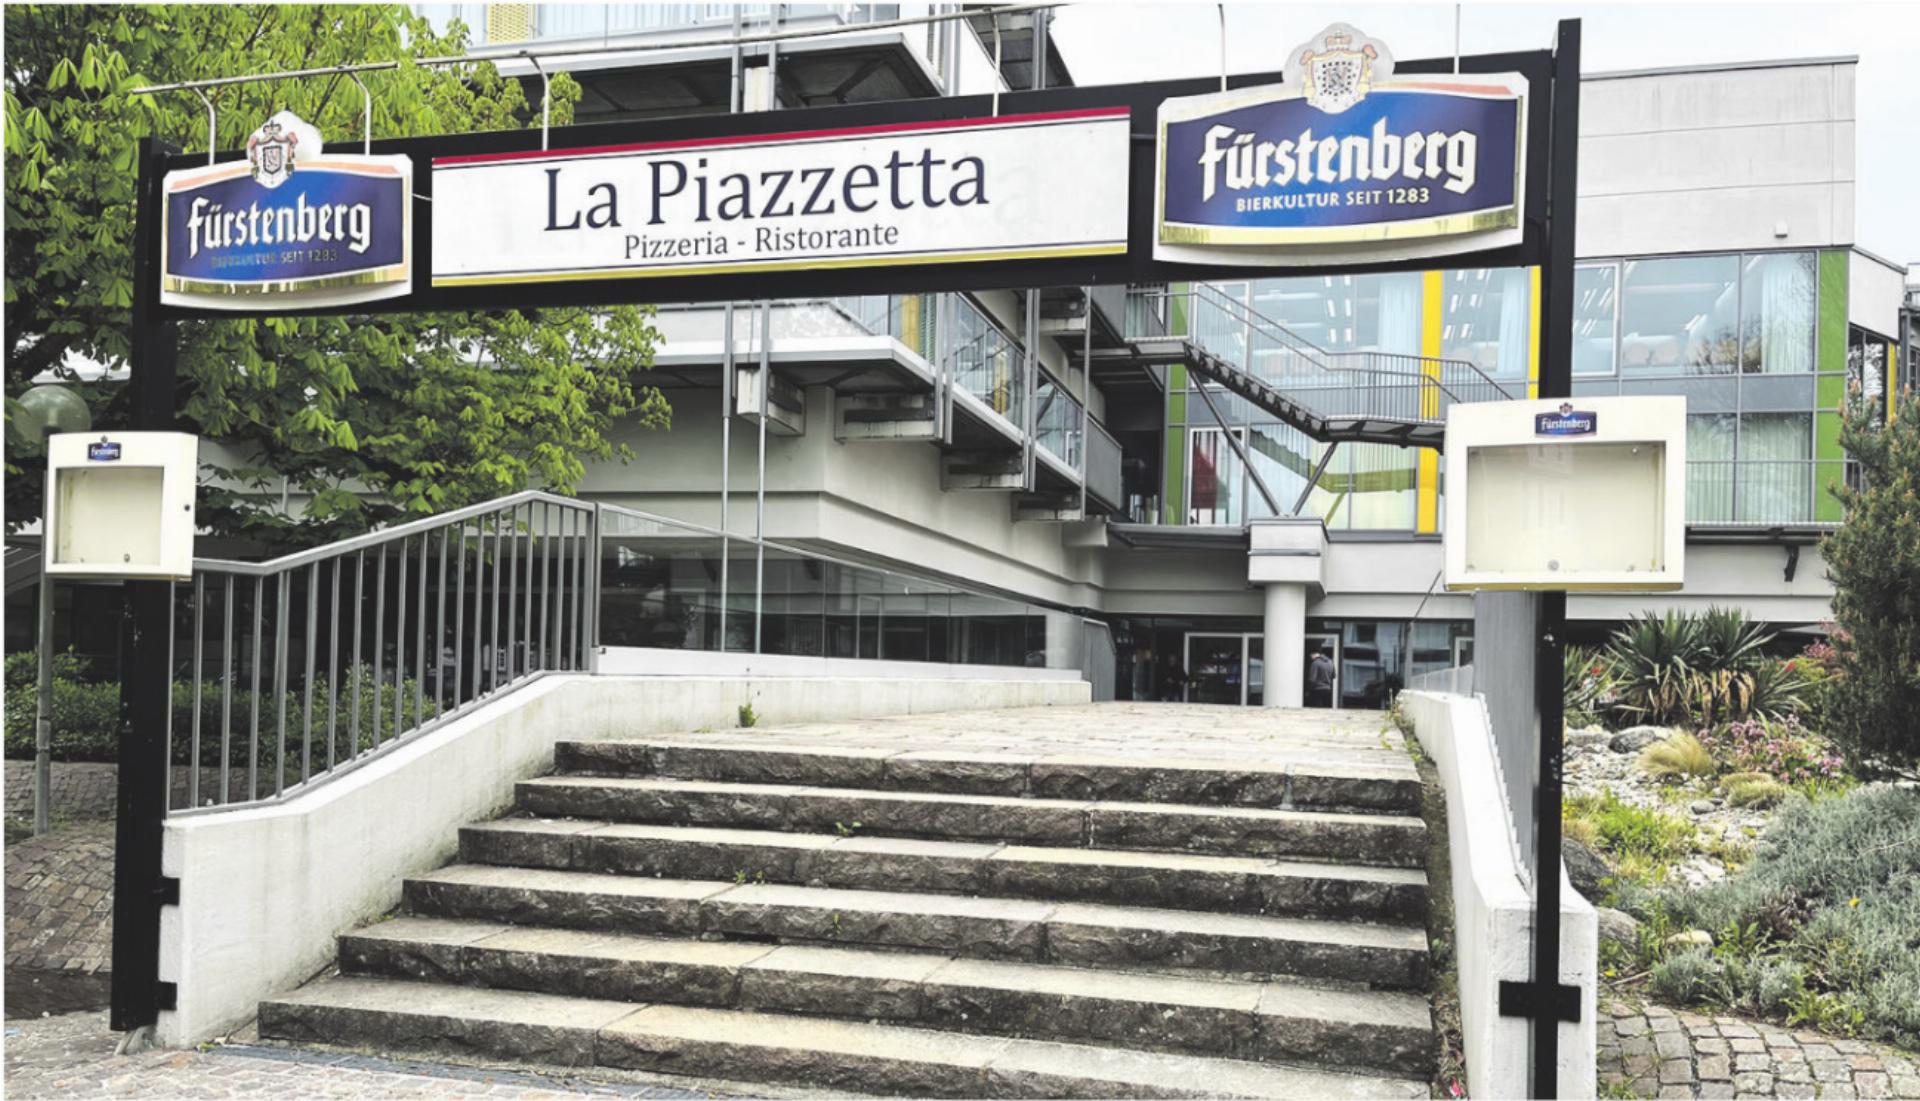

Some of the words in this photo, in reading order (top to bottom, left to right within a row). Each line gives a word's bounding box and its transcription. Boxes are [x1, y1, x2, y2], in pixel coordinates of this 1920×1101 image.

[544, 168, 622, 231] La
[647, 148, 990, 225] Piazzetta
[1236, 192, 1340, 212] BIERKULTUR
[1346, 190, 1382, 206] SEIT
[1386, 187, 1430, 205] 1283
[624, 231, 728, 259] Pizzeria
[755, 223, 899, 252] Ristorante
[281, 250, 304, 264] SEIT
